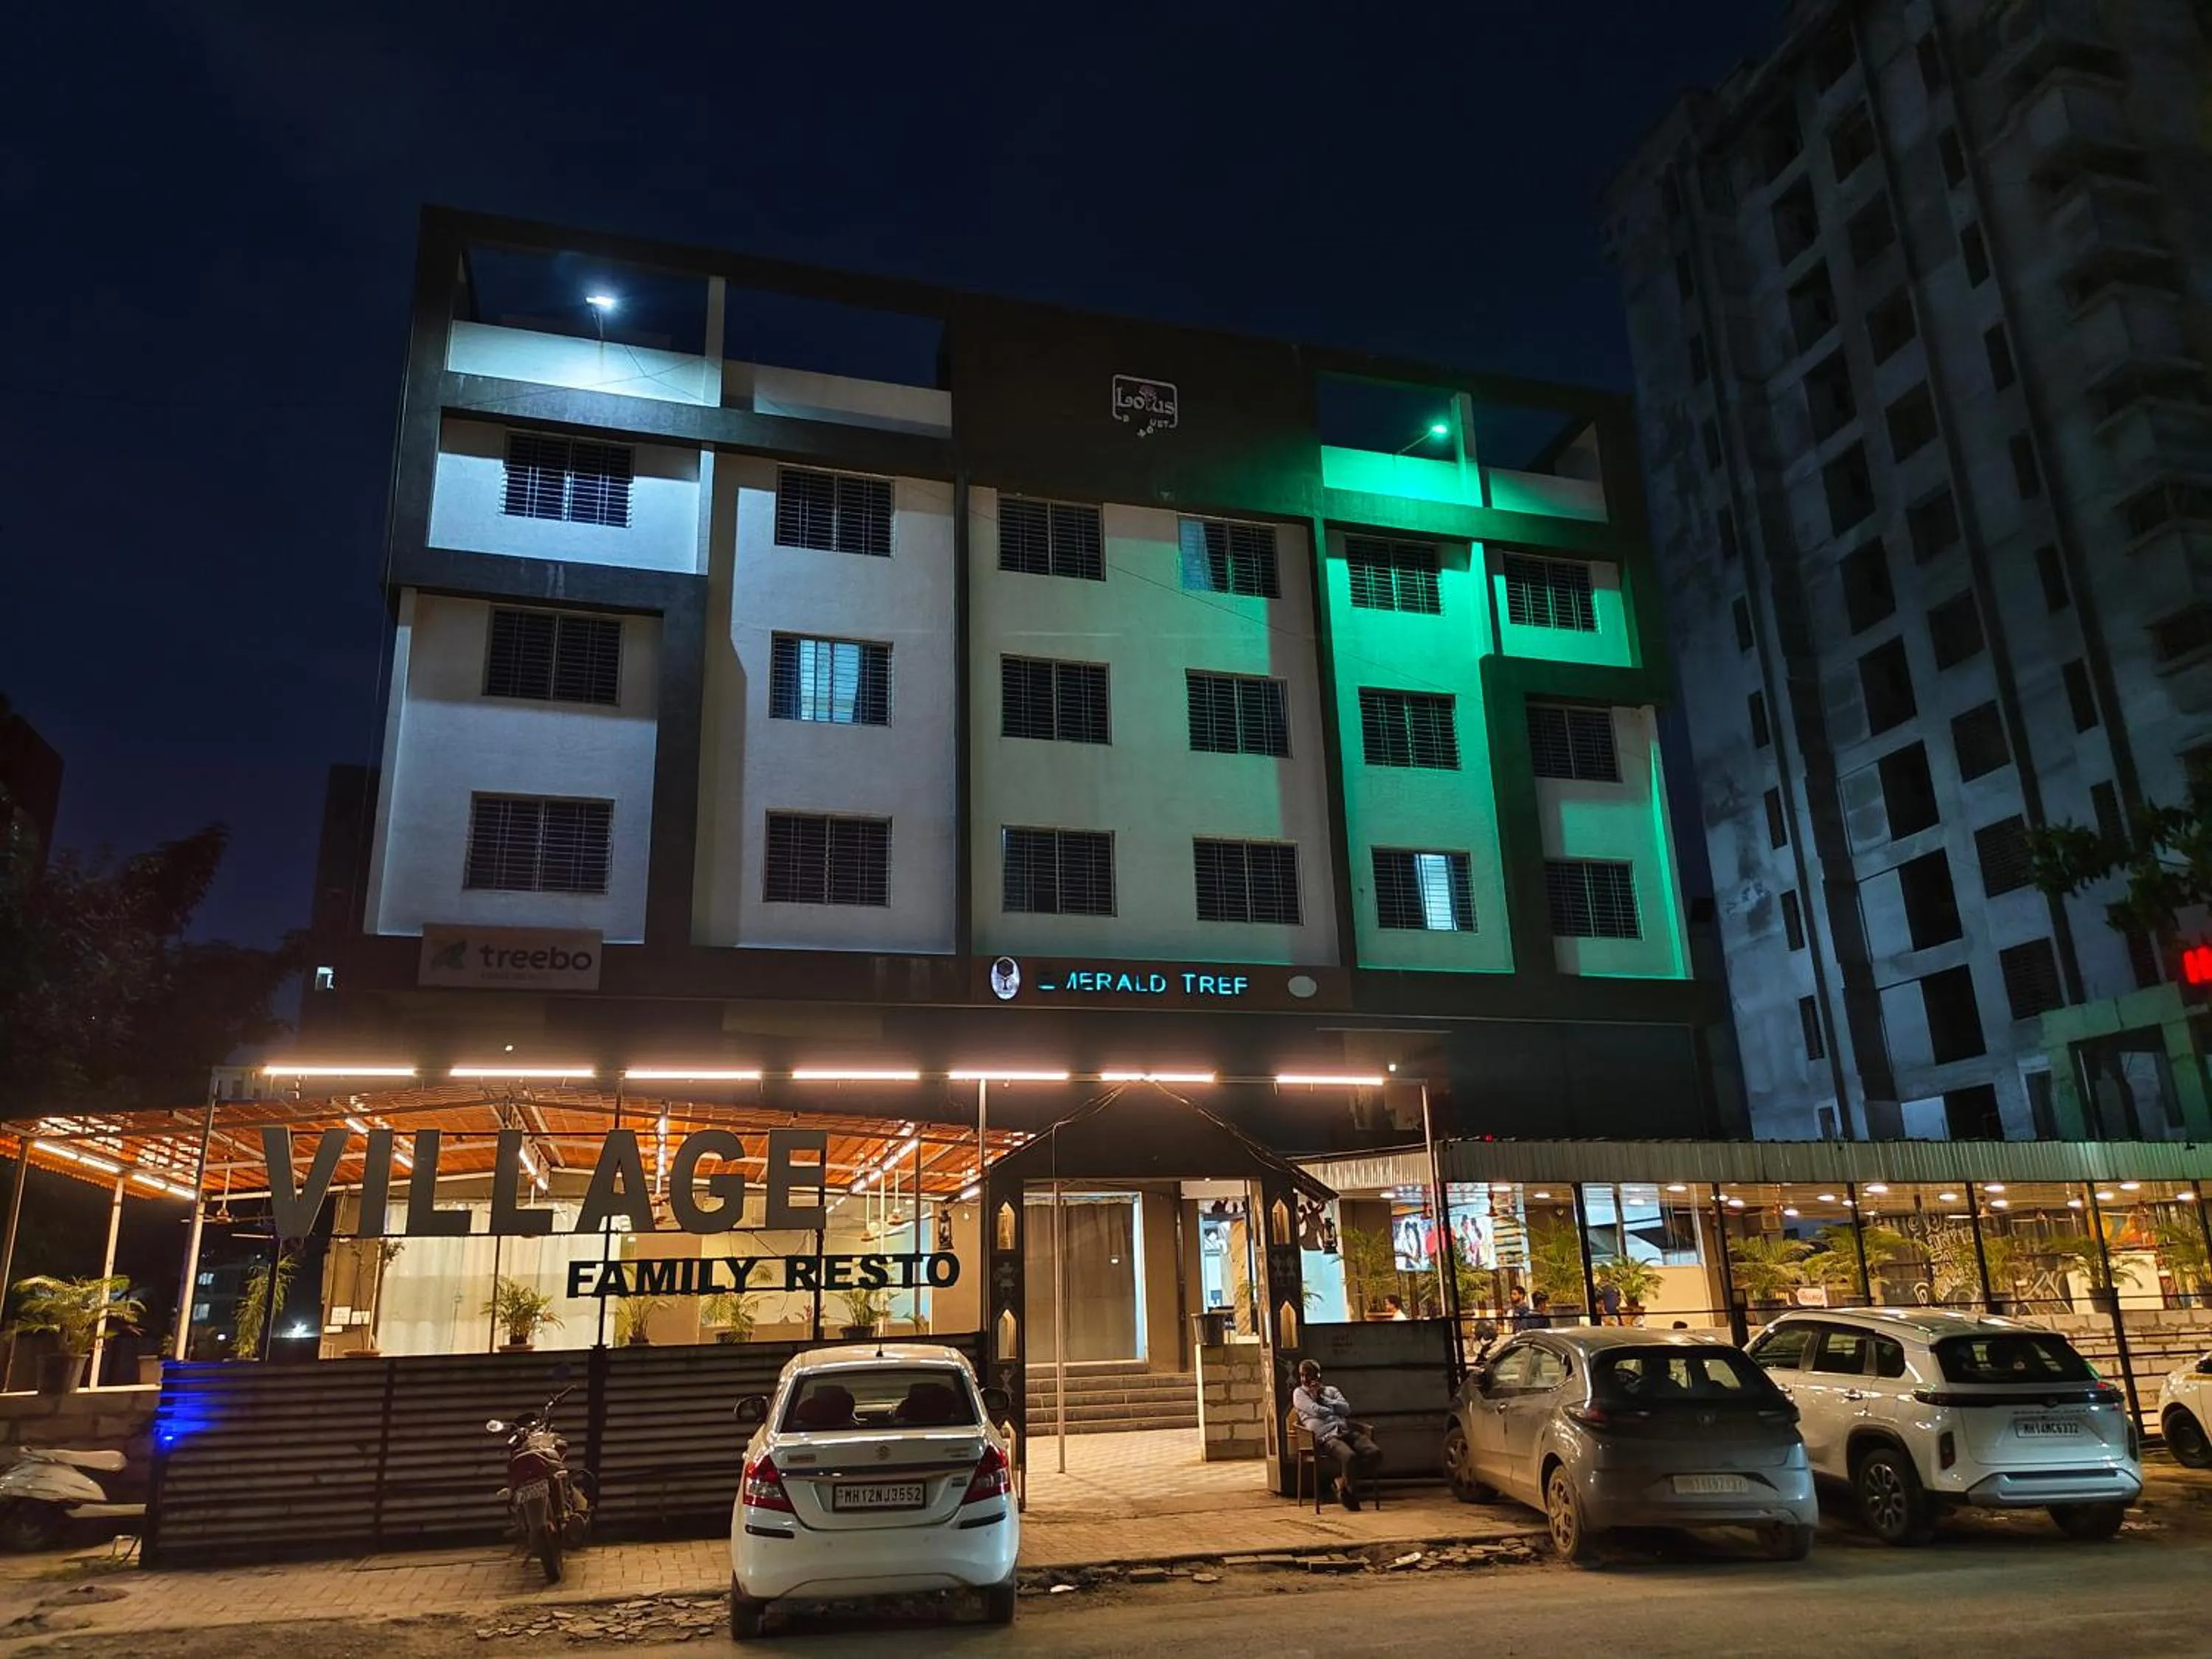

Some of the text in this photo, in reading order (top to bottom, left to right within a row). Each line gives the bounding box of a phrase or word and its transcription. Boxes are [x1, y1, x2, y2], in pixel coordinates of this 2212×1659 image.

[479, 944, 592, 971] treebo
[261, 1127, 827, 1239] VILLAGE
[566, 1252, 959, 1298] FAMILY RESTO
